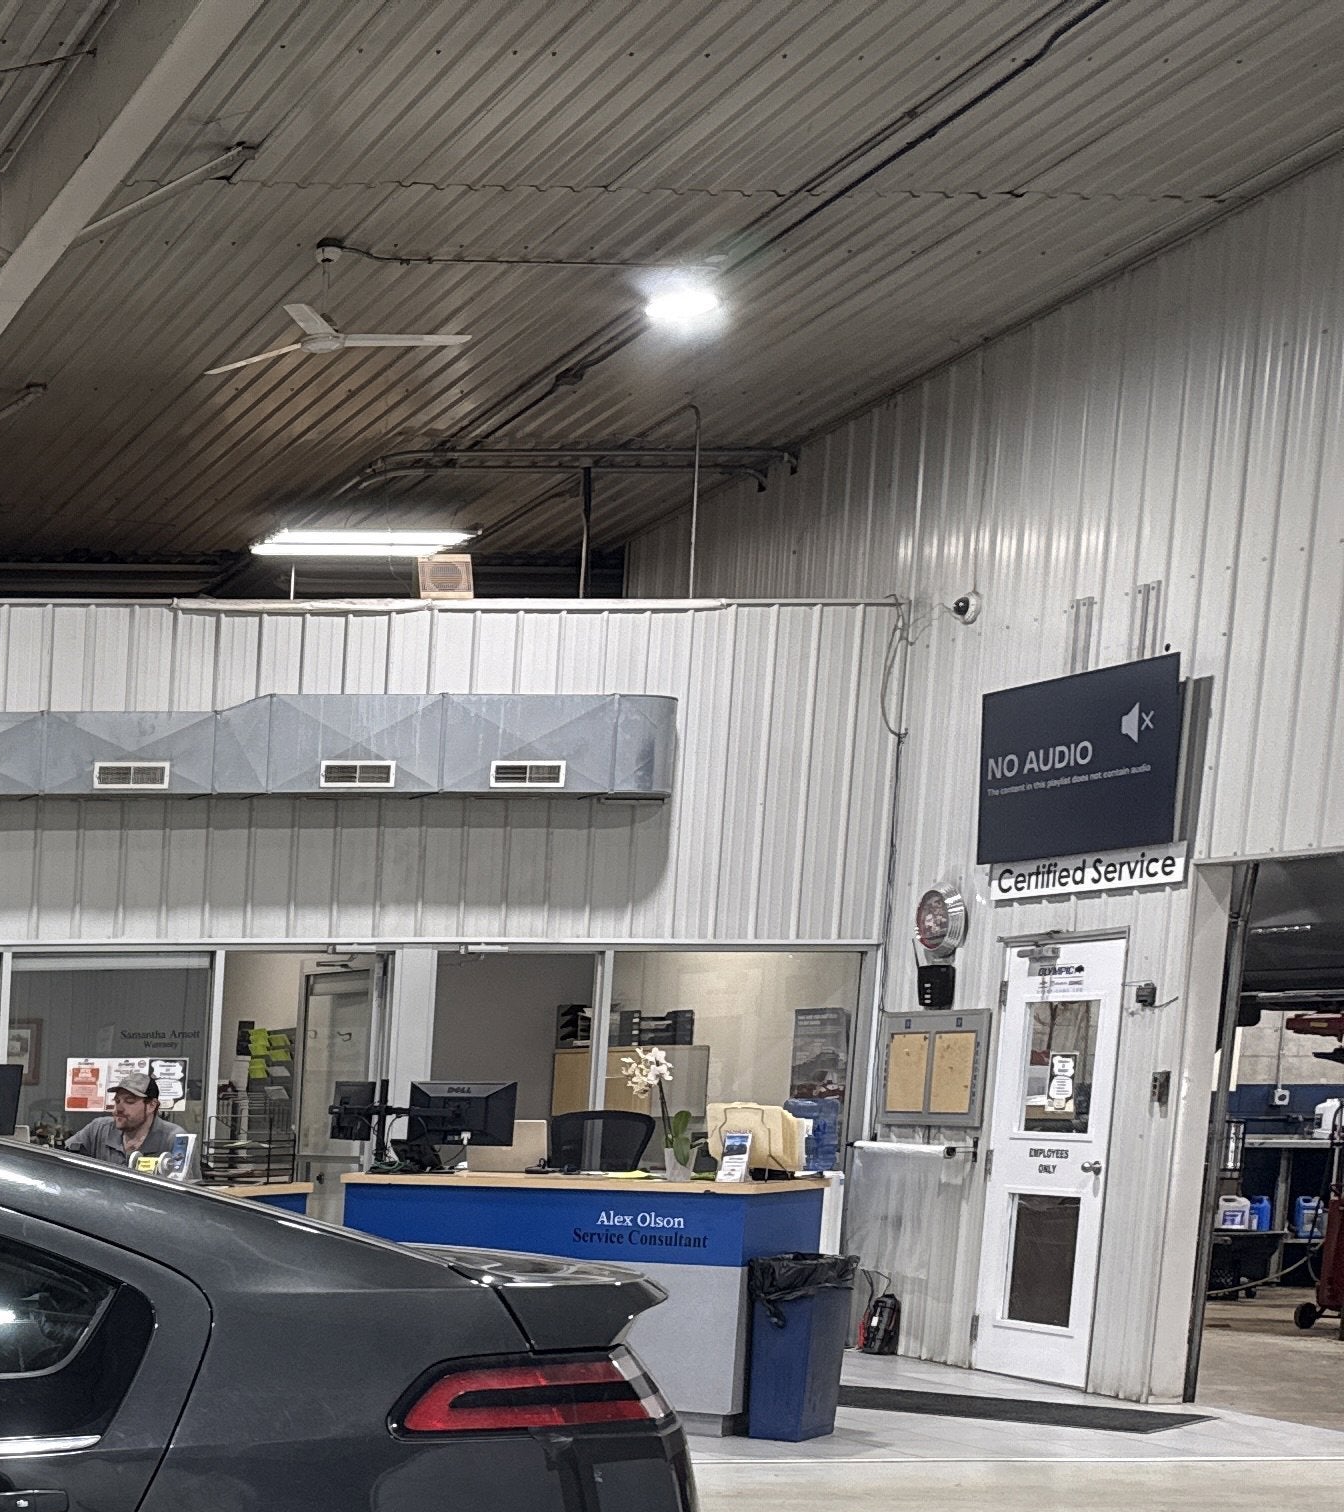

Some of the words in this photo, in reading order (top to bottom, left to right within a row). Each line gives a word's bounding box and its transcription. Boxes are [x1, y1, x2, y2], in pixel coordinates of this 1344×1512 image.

[987, 754, 1019, 781] NO
[1023, 740, 1093, 774] AUDIO
[997, 858, 1086, 893] Certified
[1091, 851, 1176, 884] Service
[120, 1029, 166, 1041] Samantha
[447, 1086, 471, 1094] DELL
[1029, 1148, 1069, 1159] EMPLOYEES
[1038, 1163, 1057, 1174] ONLY
[596, 1210, 634, 1227] Alex
[637, 1211, 684, 1229] Olson
[572, 1227, 624, 1245] Service
[628, 1229, 709, 1249] Consultant
